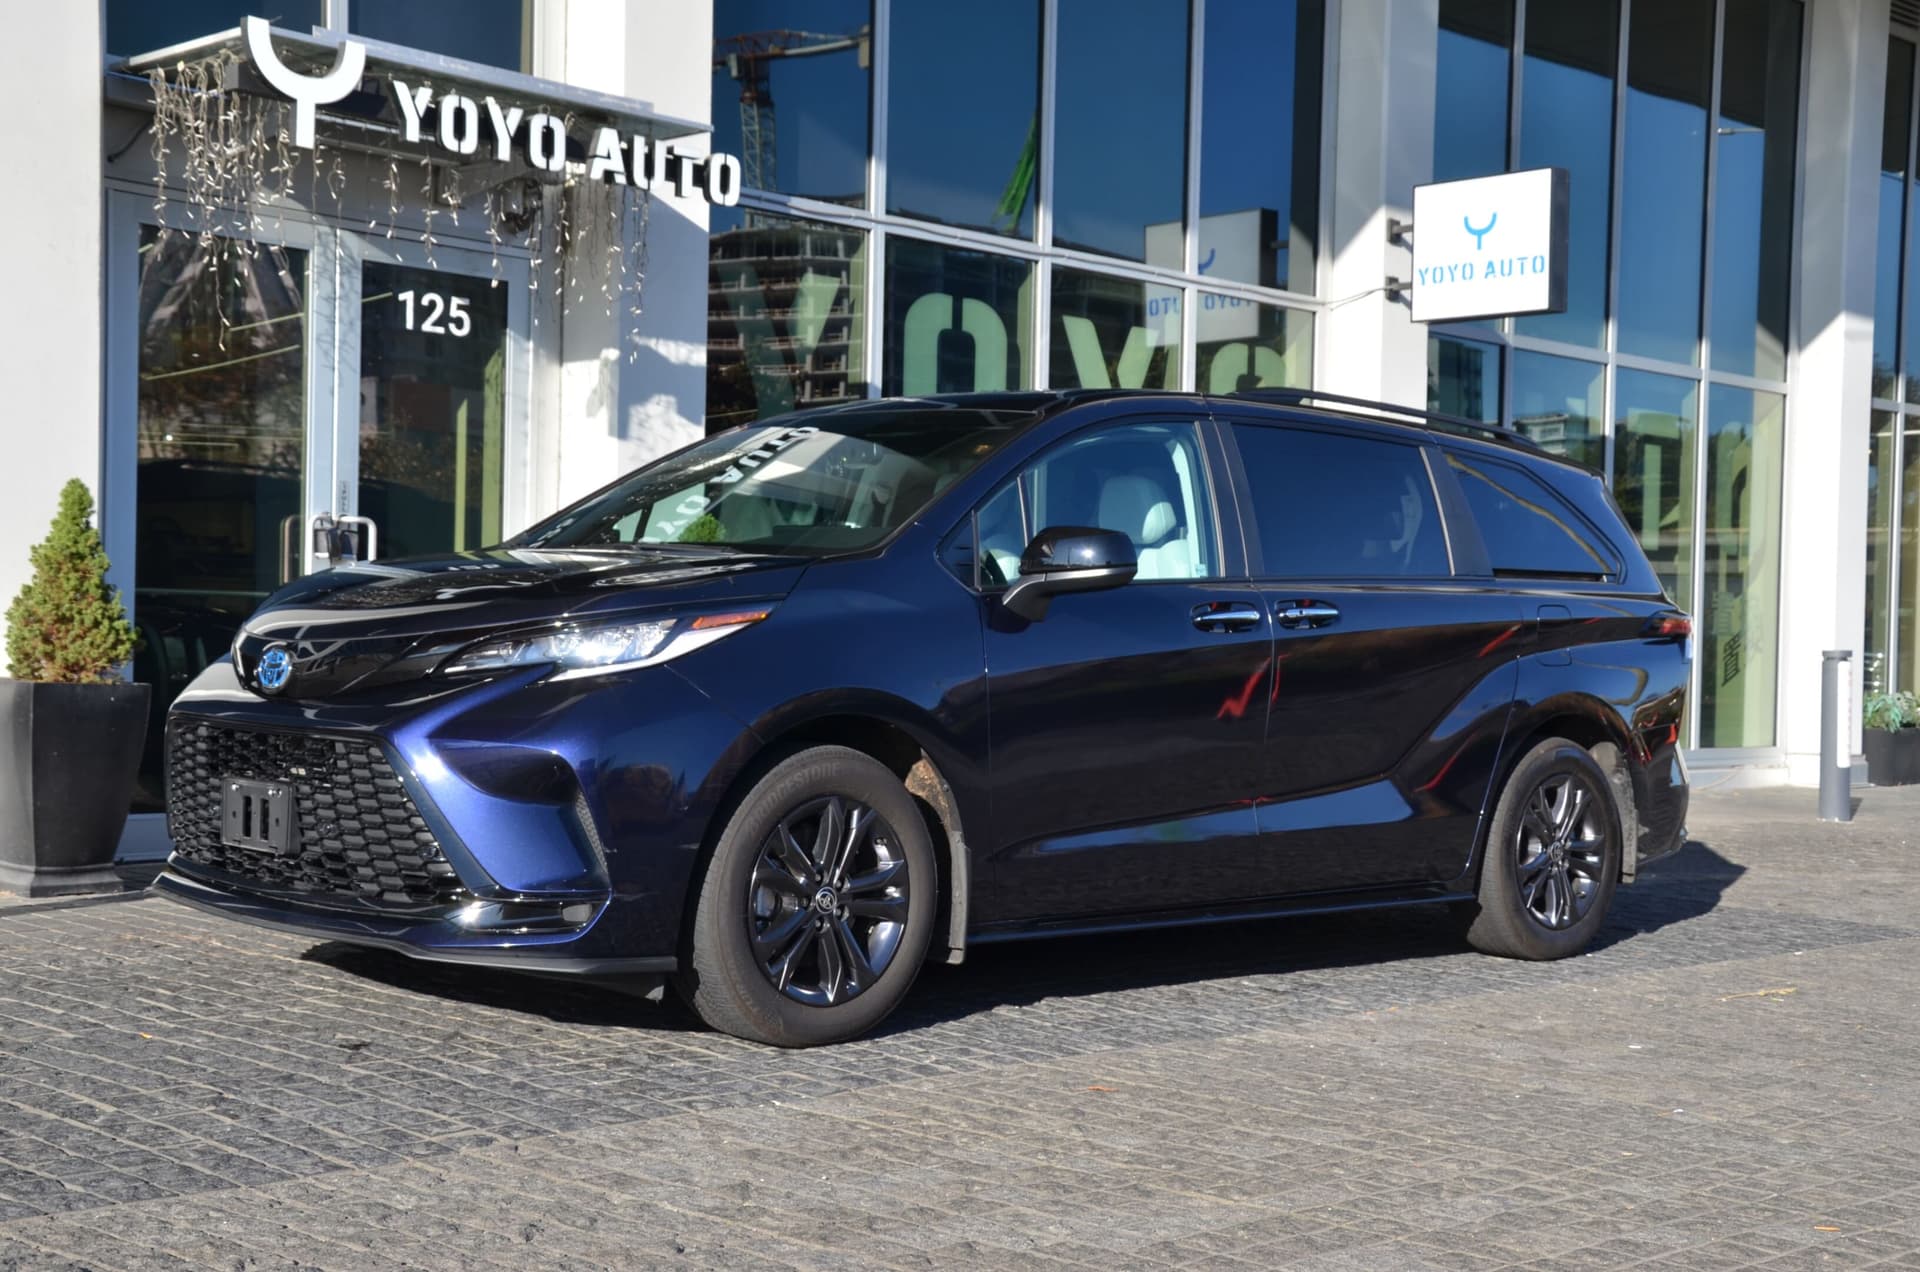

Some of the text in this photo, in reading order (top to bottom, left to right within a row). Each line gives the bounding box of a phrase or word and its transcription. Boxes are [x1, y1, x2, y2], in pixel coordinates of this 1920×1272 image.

[393, 80, 741, 207] YOYO AUTO
[1418, 255, 1545, 286] YOYO AUTO
[398, 290, 471, 337] 125
